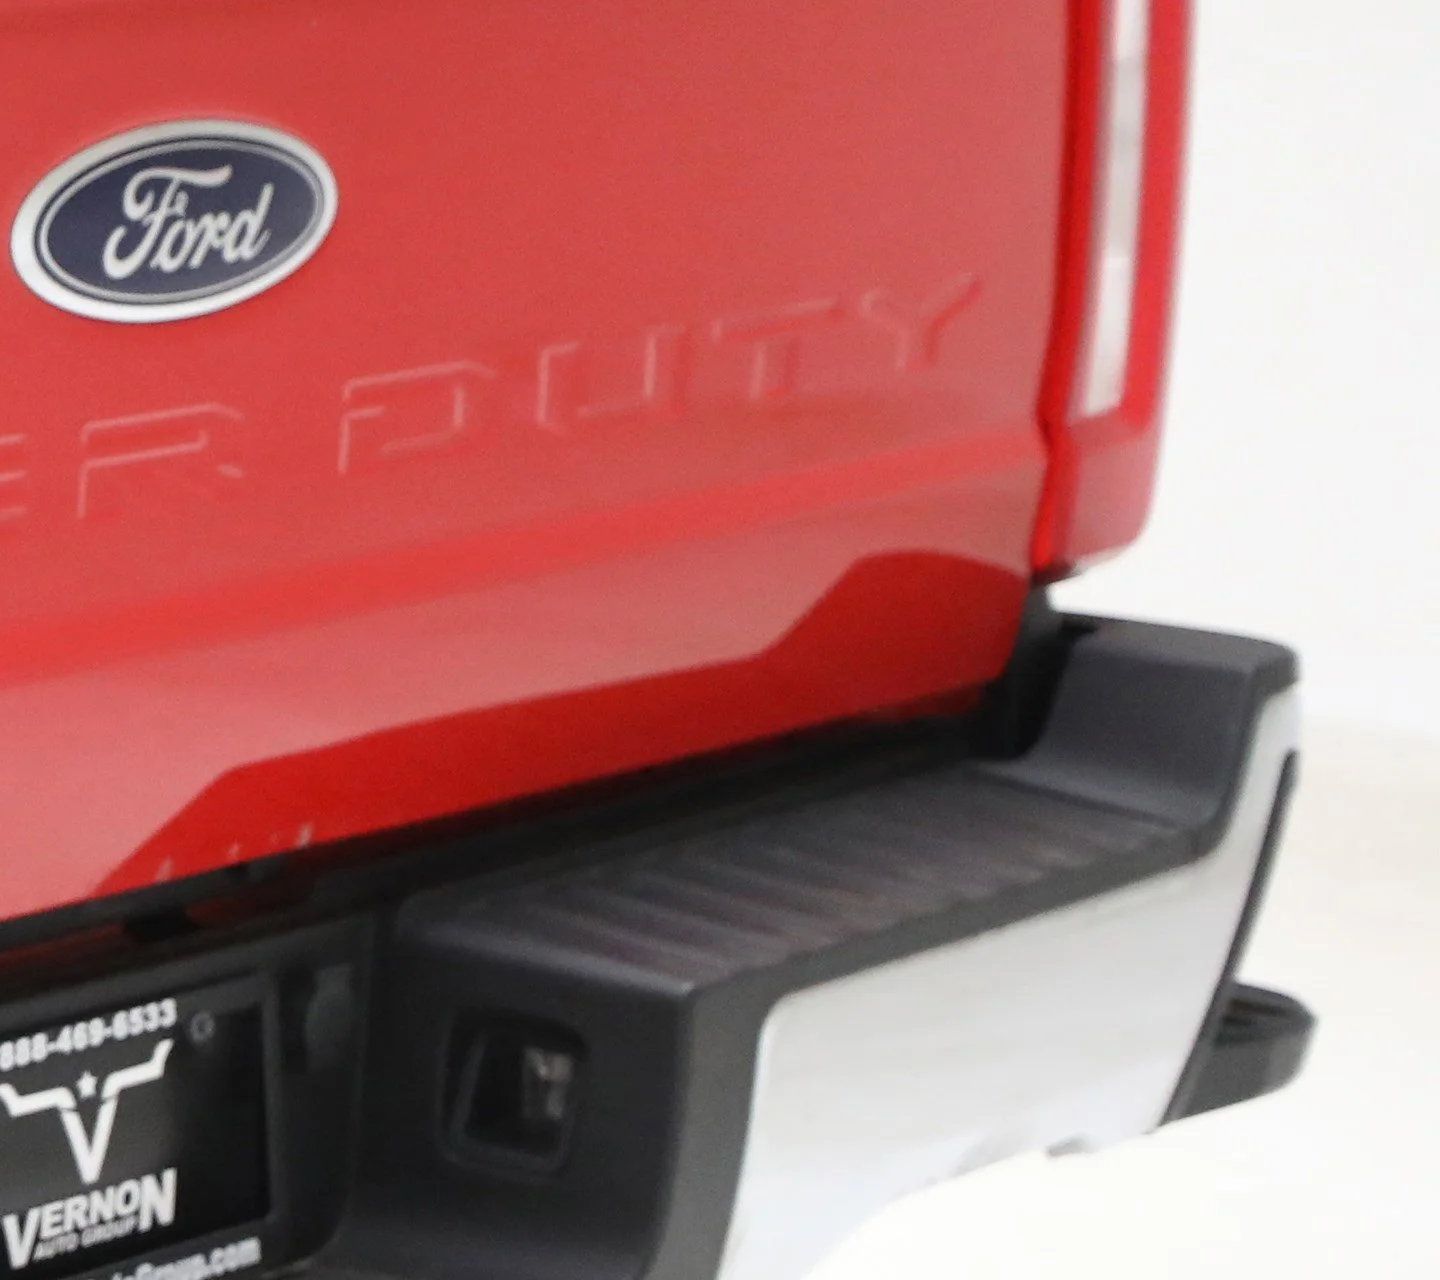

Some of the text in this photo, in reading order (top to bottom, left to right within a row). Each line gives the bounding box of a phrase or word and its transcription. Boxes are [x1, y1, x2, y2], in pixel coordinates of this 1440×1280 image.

[102, 164, 276, 280] Ford
[337, 272, 980, 477] DUTY
[2, 1166, 178, 1270] VERNON
[33, 1231, 80, 1261] AUTO
